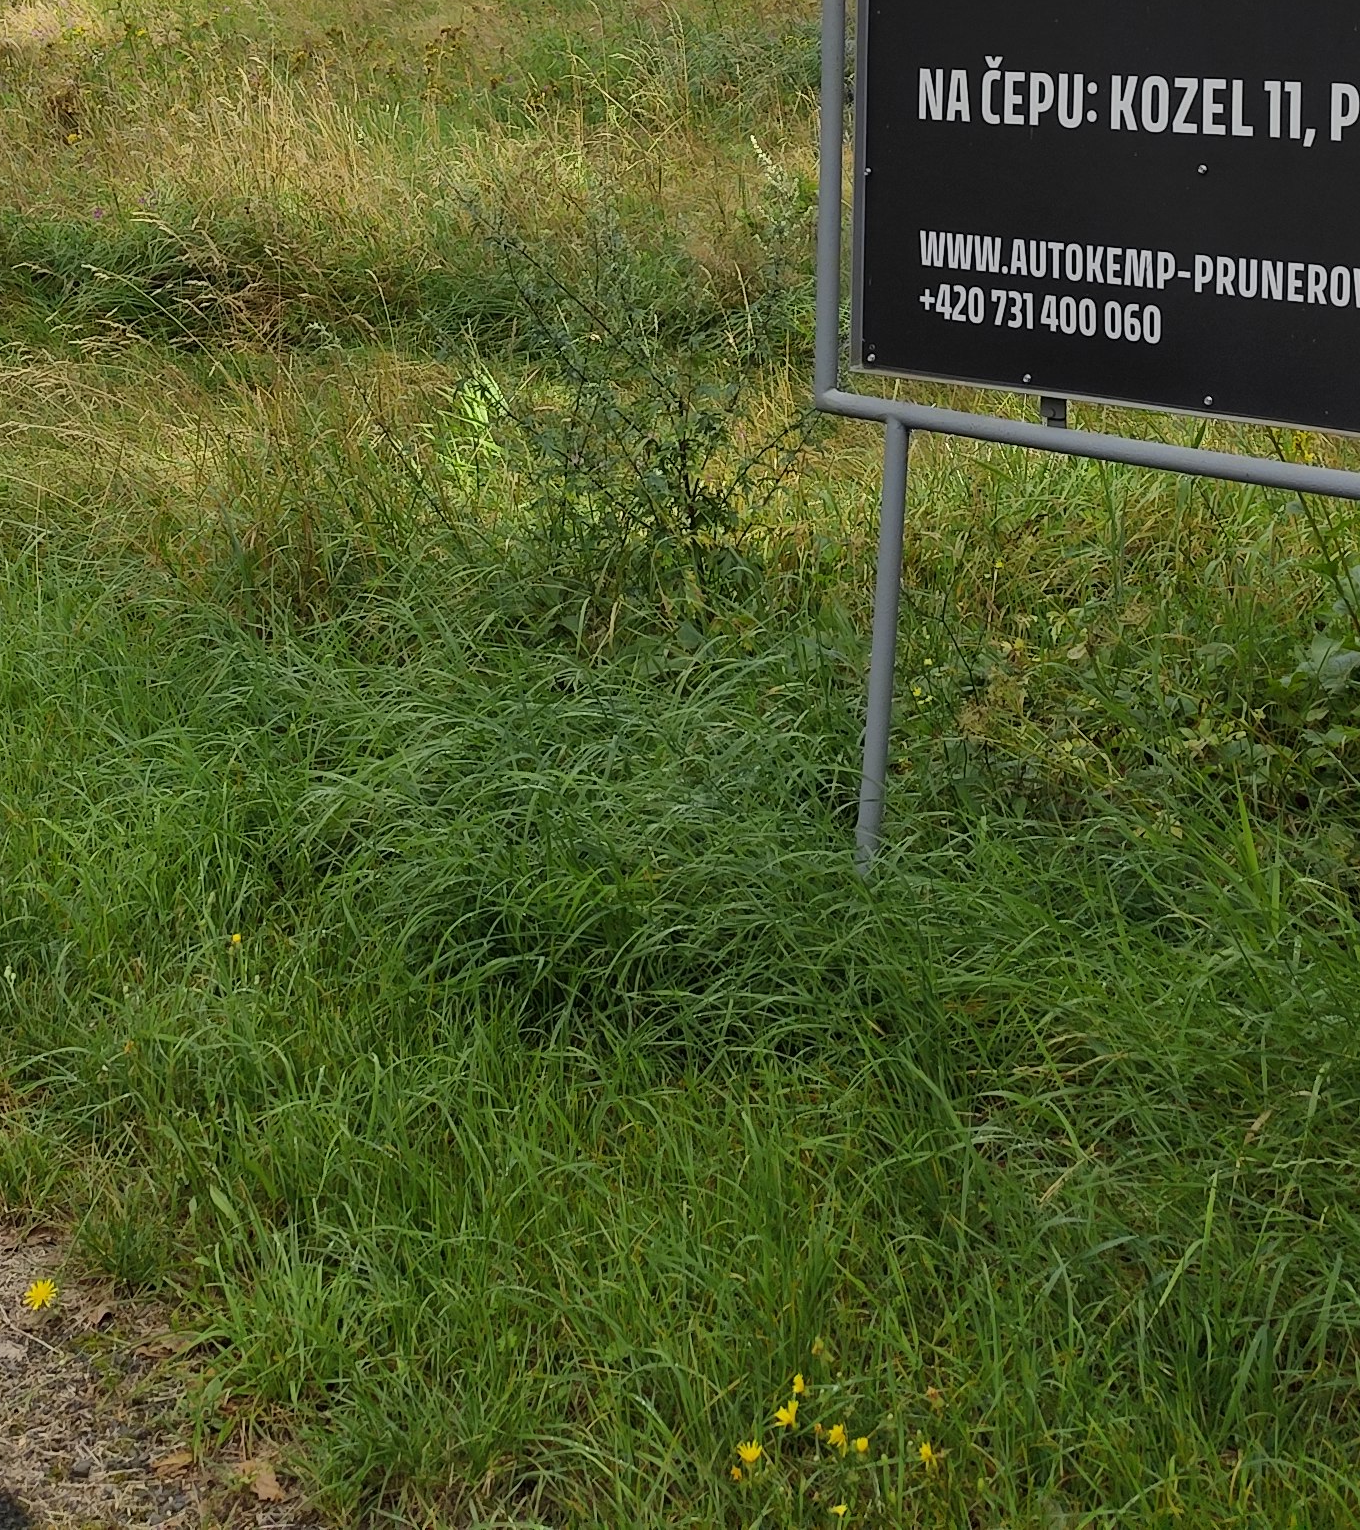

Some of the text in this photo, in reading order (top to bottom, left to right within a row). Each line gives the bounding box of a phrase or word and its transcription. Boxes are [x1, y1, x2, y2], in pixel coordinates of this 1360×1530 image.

[919, 68, 970, 122] NA
[982, 56, 1097, 128] ČEPU:
[1111, 75, 1253, 136] KOZEL
[1264, 81, 1315, 147] 11,
[920, 284, 1160, 343] +420 731 400 060
